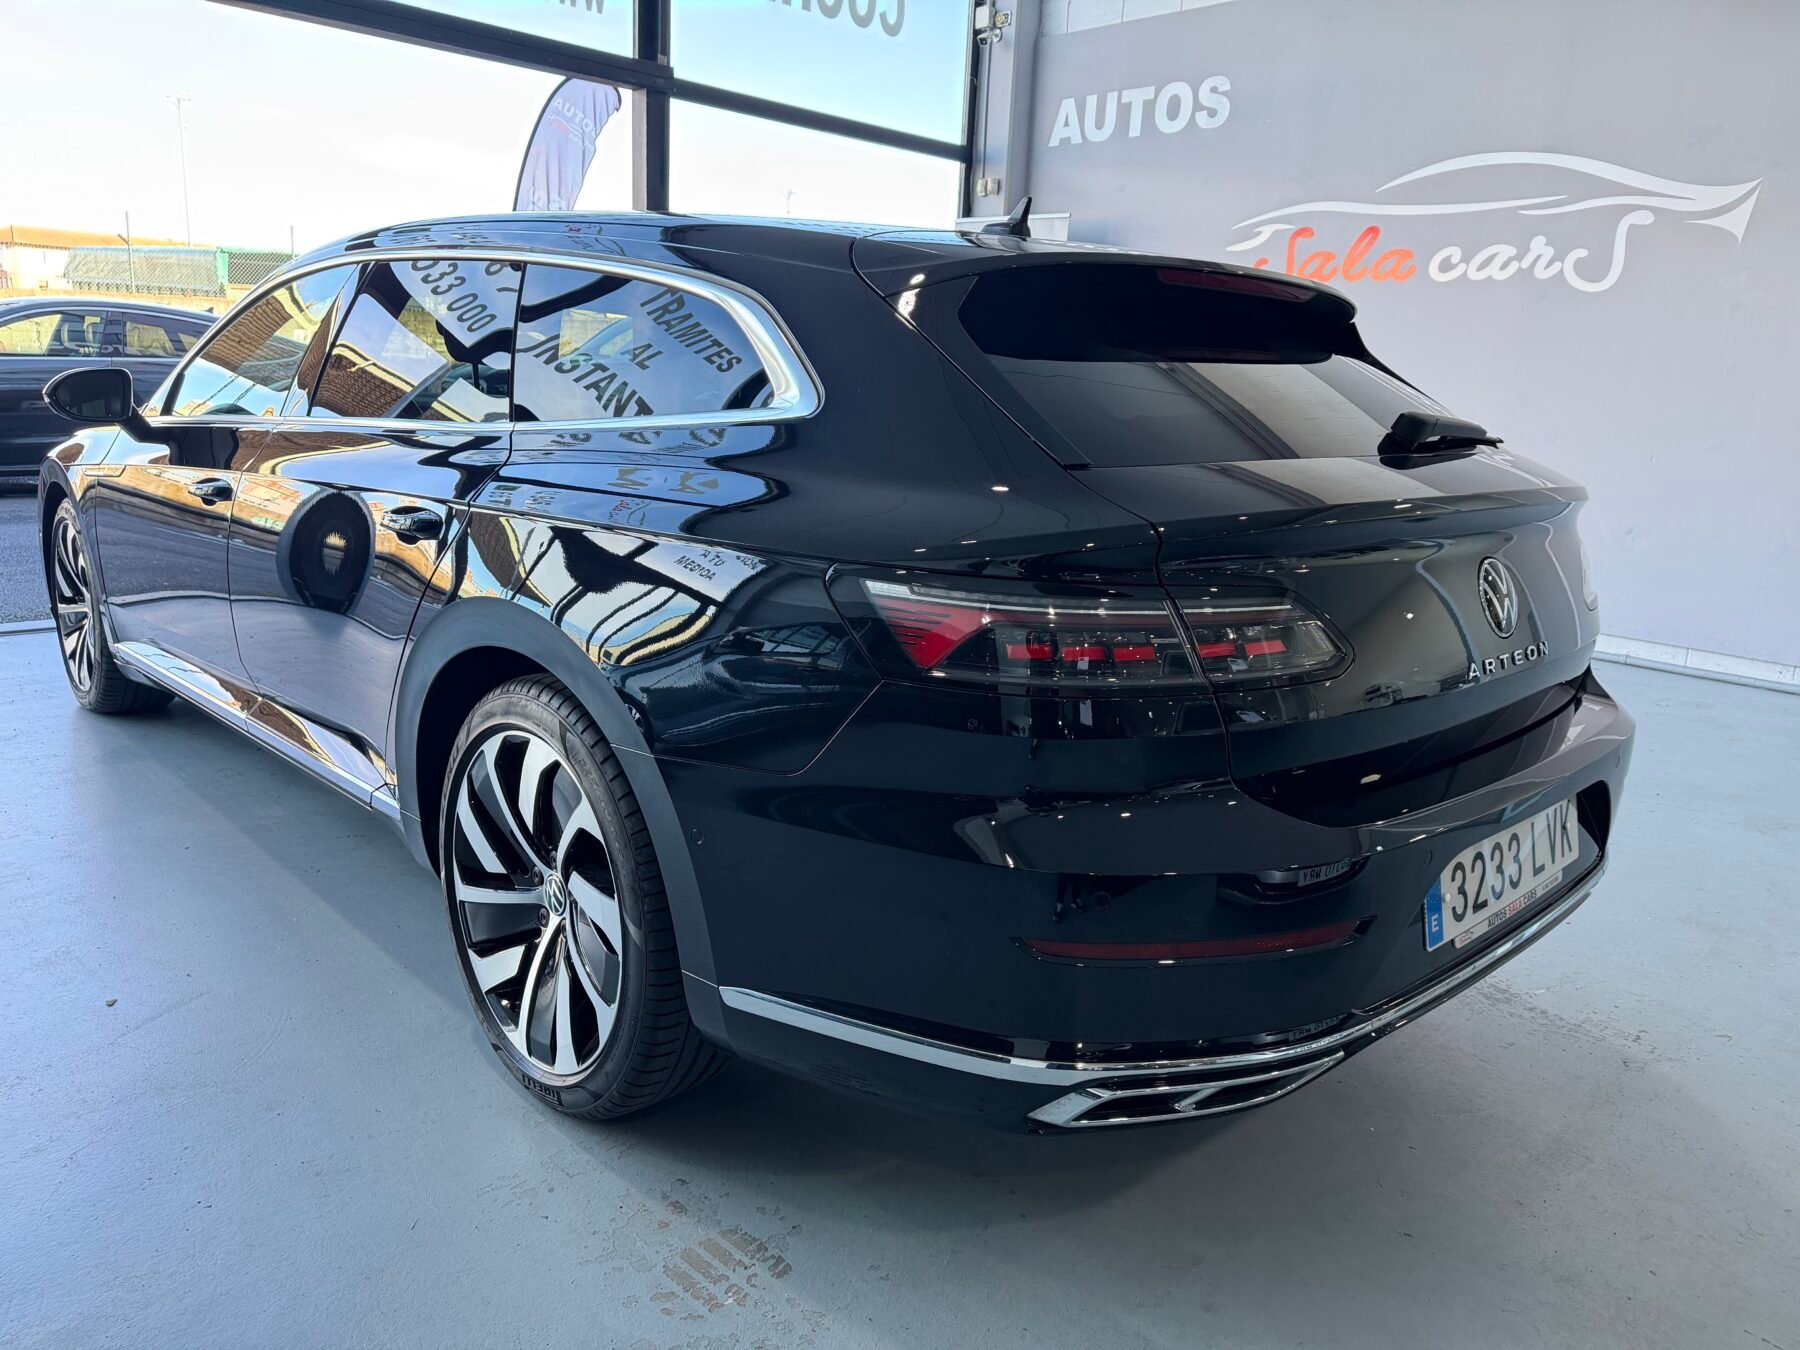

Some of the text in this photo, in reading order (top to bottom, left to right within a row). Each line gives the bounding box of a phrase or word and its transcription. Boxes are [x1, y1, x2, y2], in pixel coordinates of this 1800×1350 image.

[1048, 75, 1231, 147] AUTOS
[446, 292, 497, 333] 000
[640, 287, 743, 373] TRAMITES
[622, 343, 663, 371] AL
[1467, 641, 1549, 680] ARTEON
[1451, 799, 1573, 923] 3233 LVK
[1431, 914, 1439, 932] E
[1487, 887, 1537, 929] AUTOS SALA CARS
